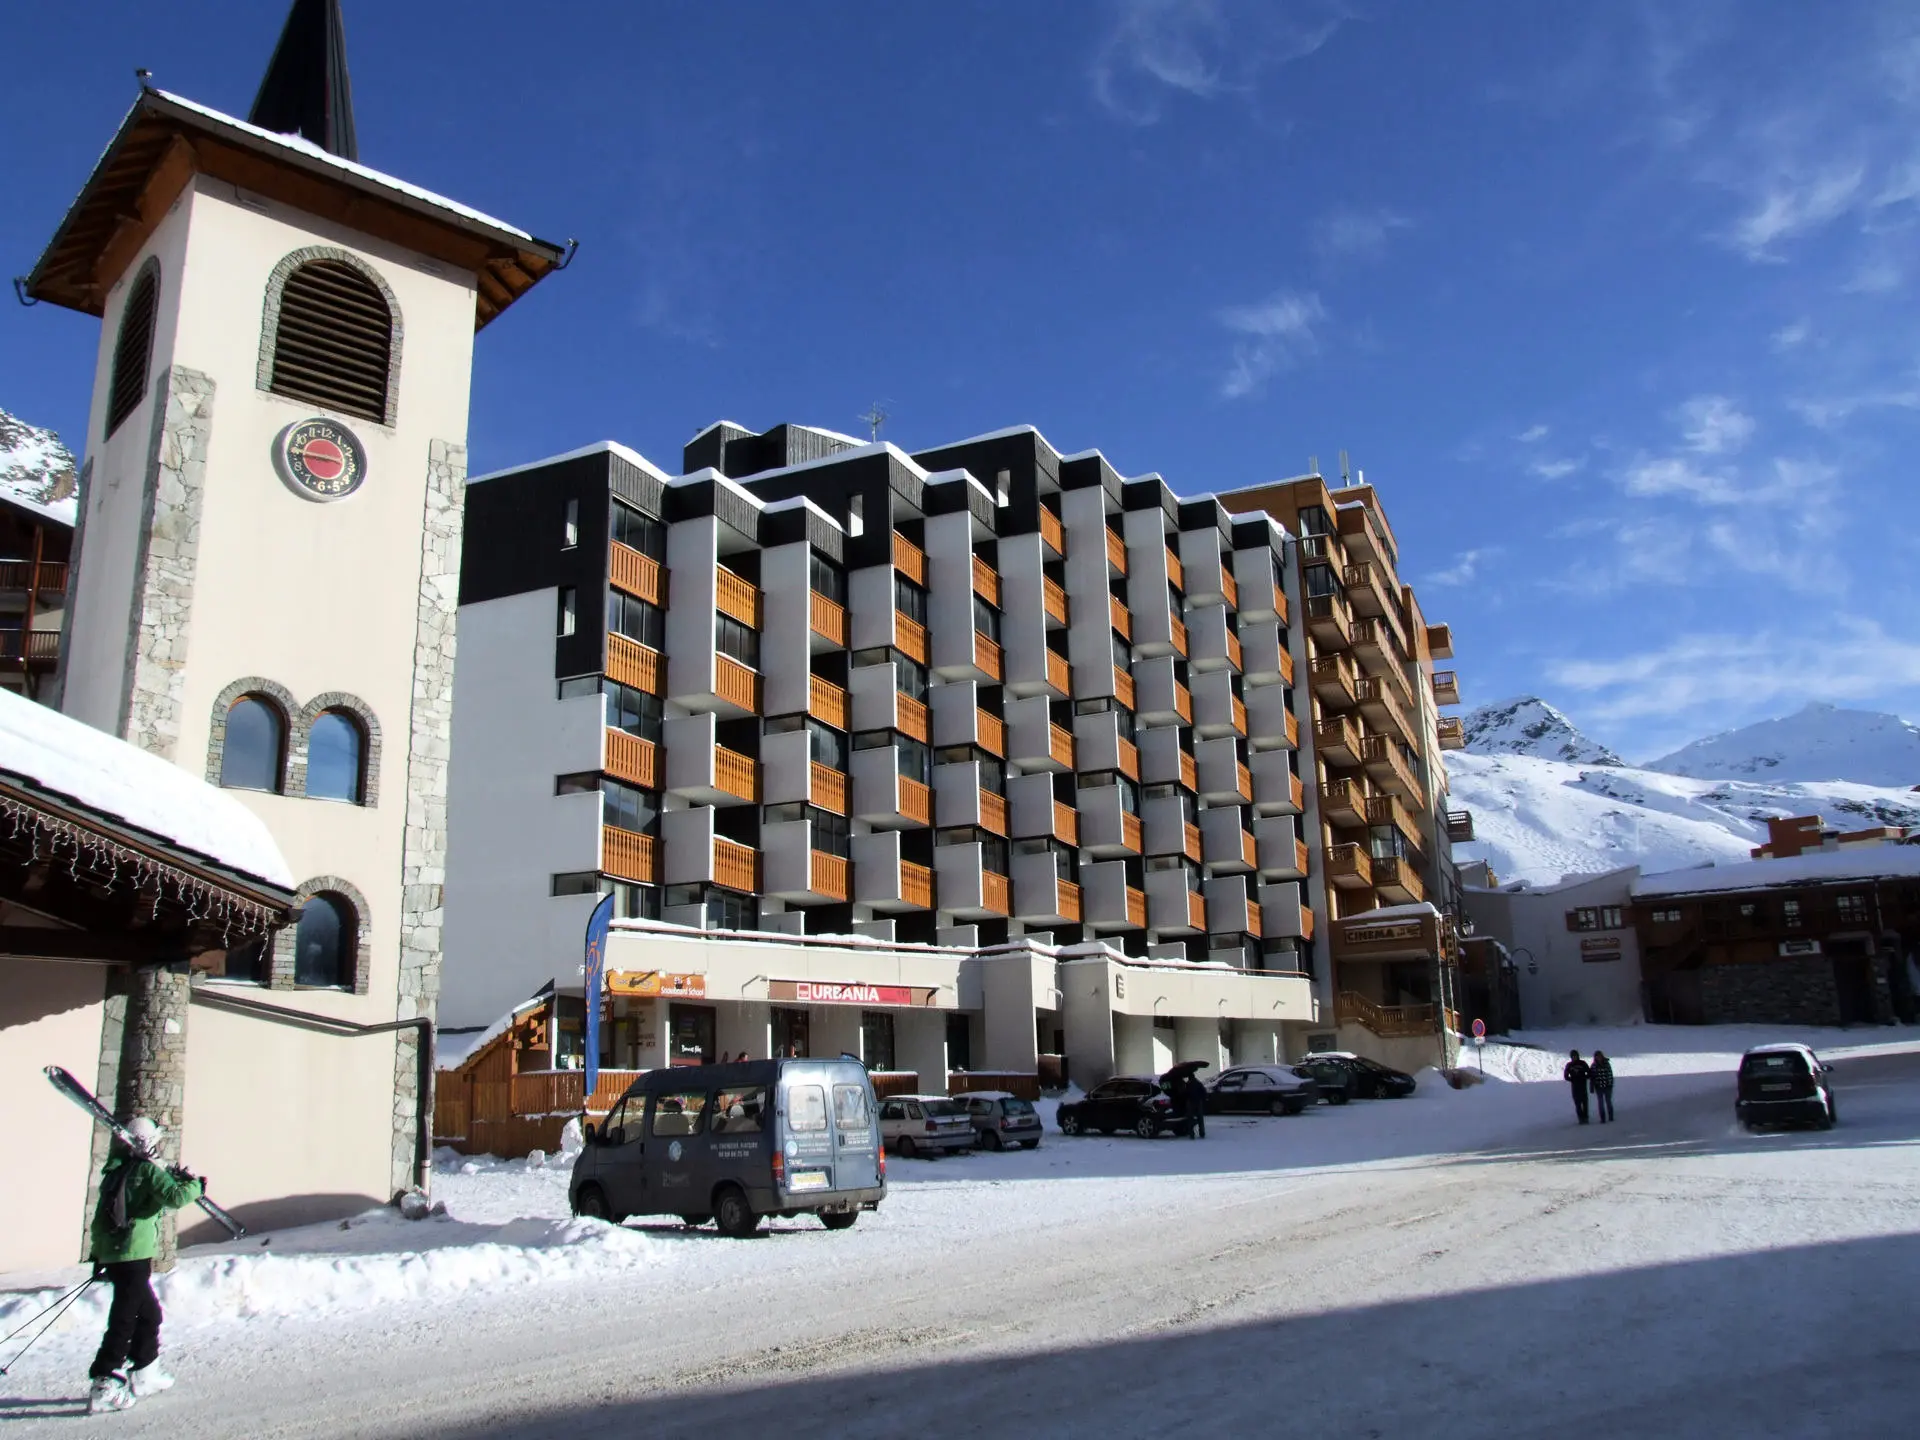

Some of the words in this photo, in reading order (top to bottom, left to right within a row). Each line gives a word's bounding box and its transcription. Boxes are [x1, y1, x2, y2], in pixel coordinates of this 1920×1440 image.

[321, 427, 333, 439] 12
[296, 433, 307, 445] 10
[337, 435, 342, 445] 1
[345, 447, 353, 457] 2
[294, 461, 302, 472] 8
[348, 463, 356, 473] 3
[304, 474, 312, 485] 7
[342, 475, 350, 485] 4
[317, 481, 326, 492] 6
[332, 481, 341, 492] 5
[1347, 928, 1395, 941] CINEMA
[688, 987, 704, 996] School
[812, 983, 880, 1001] URBANIA
